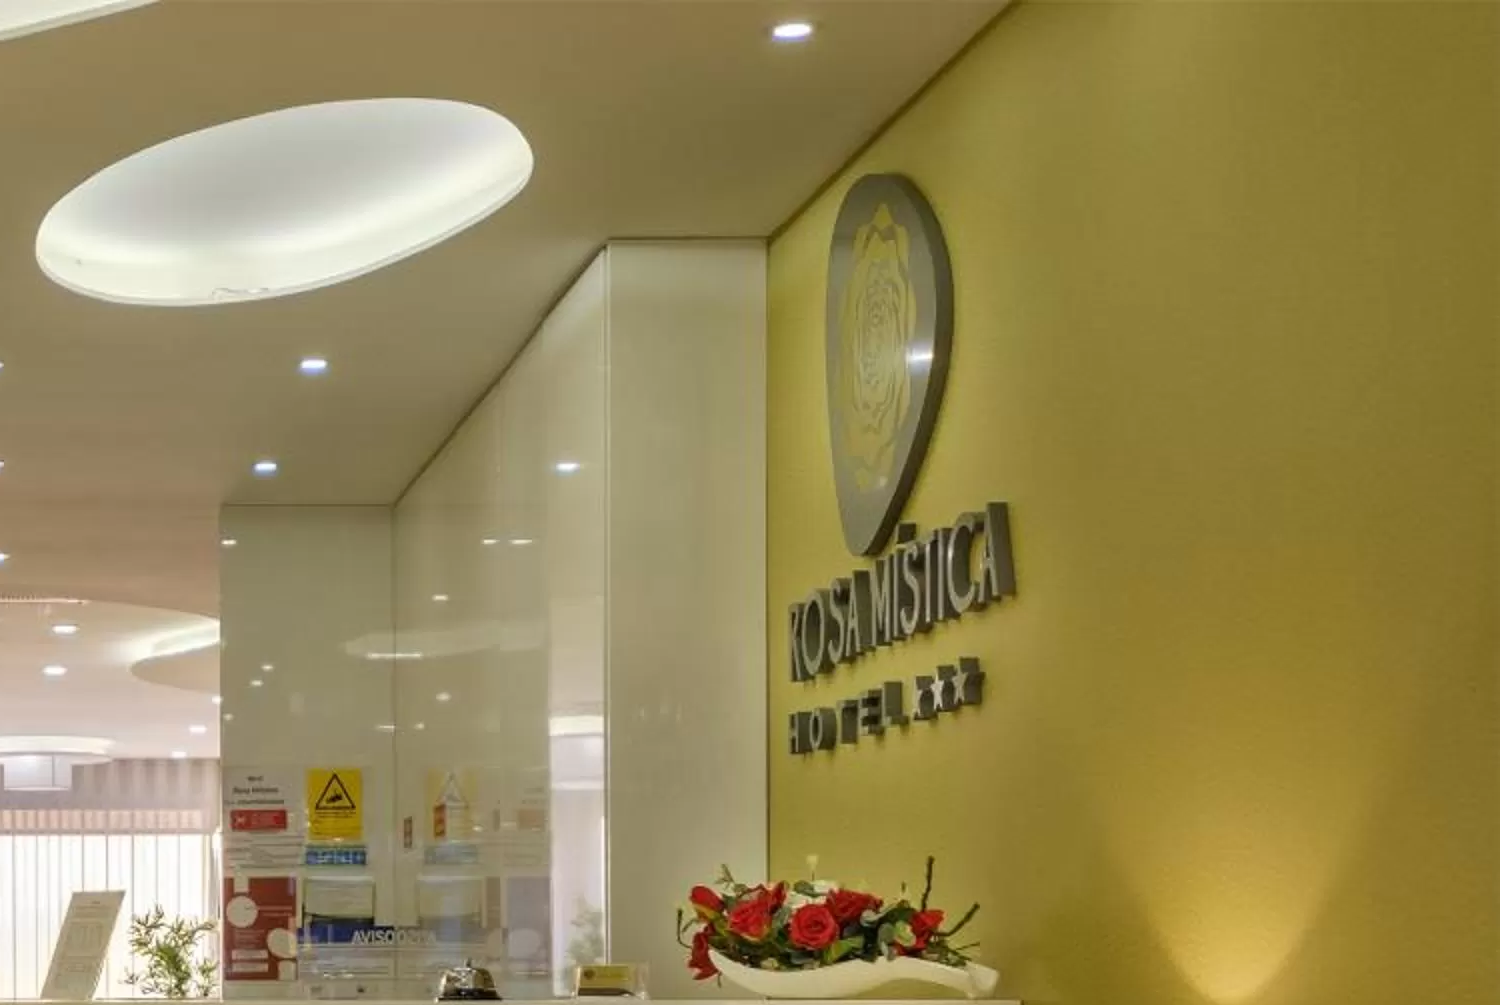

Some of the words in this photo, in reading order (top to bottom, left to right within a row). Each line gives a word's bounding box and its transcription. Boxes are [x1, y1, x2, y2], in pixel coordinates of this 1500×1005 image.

[789, 569, 875, 682] ROSA
[789, 681, 909, 754] HOTEL
[352, 929, 394, 945] AVISO
